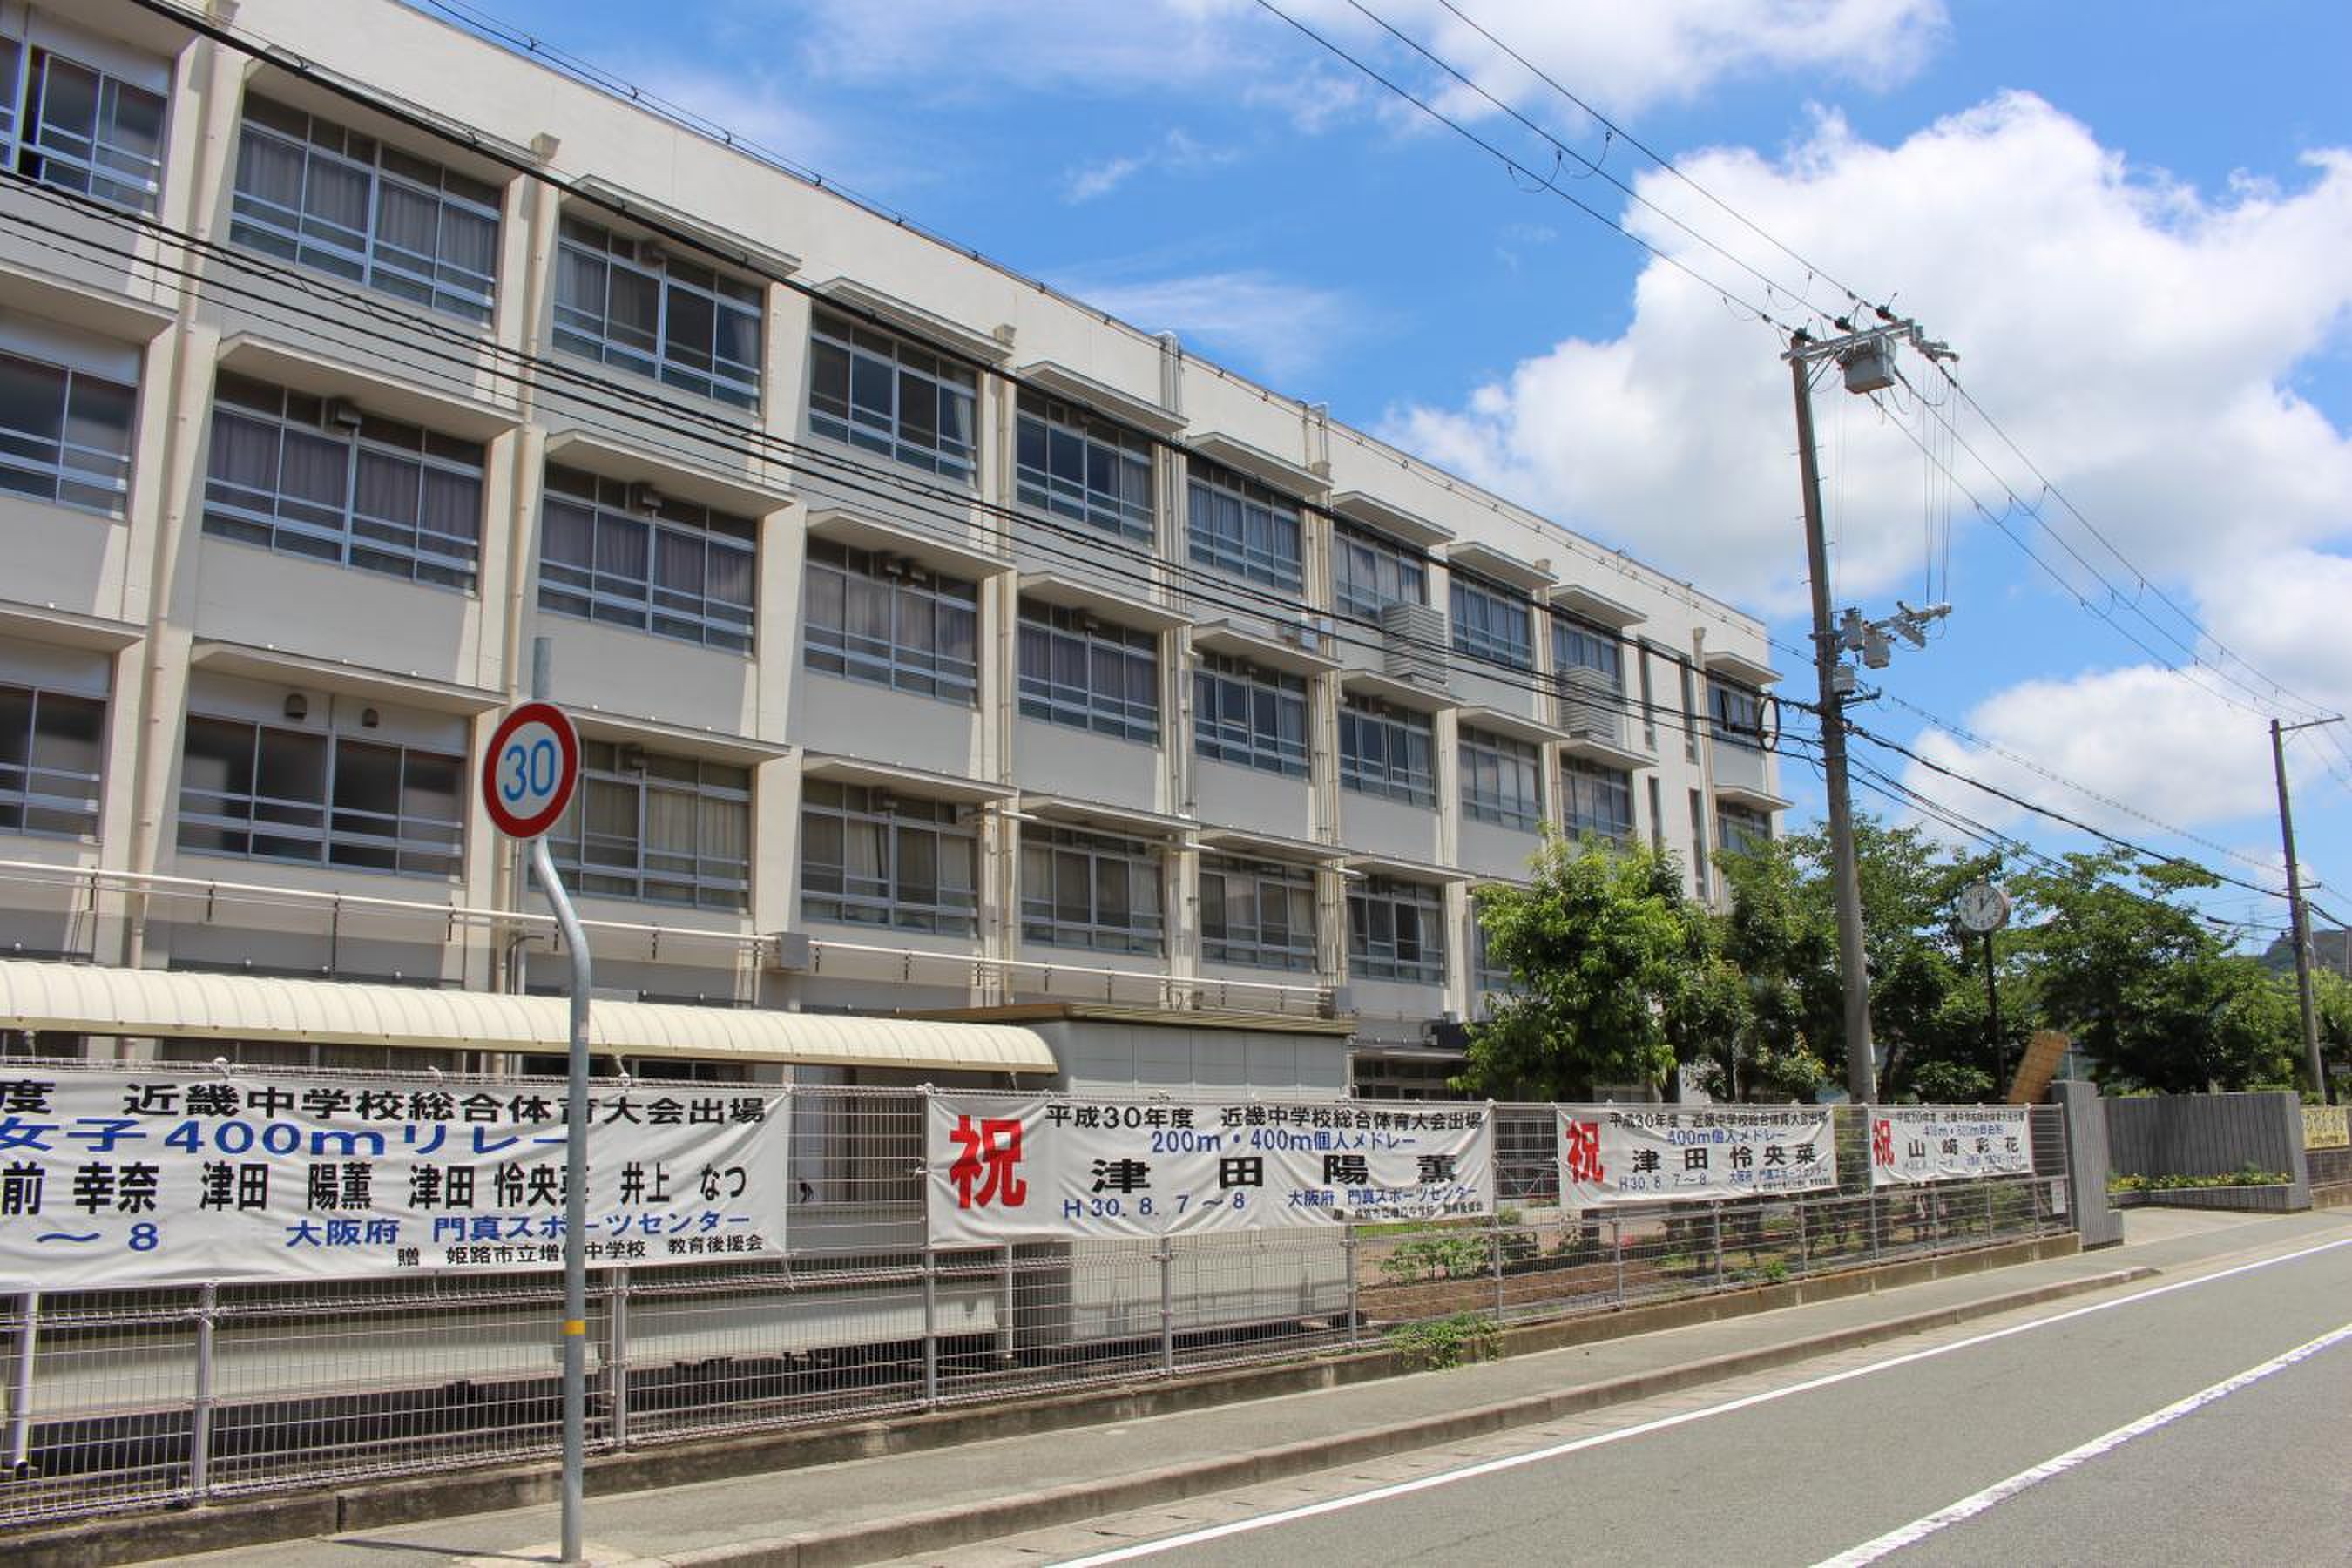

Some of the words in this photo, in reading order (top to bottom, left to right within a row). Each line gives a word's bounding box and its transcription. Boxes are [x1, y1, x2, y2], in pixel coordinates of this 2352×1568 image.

[504, 739, 555, 801] 30
[0, 1079, 55, 1114] 度
[123, 1083, 766, 1125] 近畿中学校総合体育大会出場
[1046, 1105, 1194, 1129] 平成30年度
[1220, 1107, 1482, 1130] 近畿中学校総合体育大会出場
[949, 1115, 1027, 1209] 祝
[1566, 1121, 1604, 1184] 祝
[2, 1161, 45, 1215] 前
[73, 1161, 159, 1214] 幸奈
[199, 1160, 269, 1211] 津田
[308, 1162, 373, 1210] 陽薫
[409, 1164, 475, 1209] 津田
[620, 1161, 670, 1205] 井上
[700, 1163, 747, 1201] なつ
[1288, 1190, 1335, 1208] 大阪府
[285, 1219, 400, 1247] 大阪府
[398, 1247, 419, 1266] 贈
[446, 1240, 646, 1265] 姫路市立増中学校
[668, 1235, 764, 1255] 教育後援会
